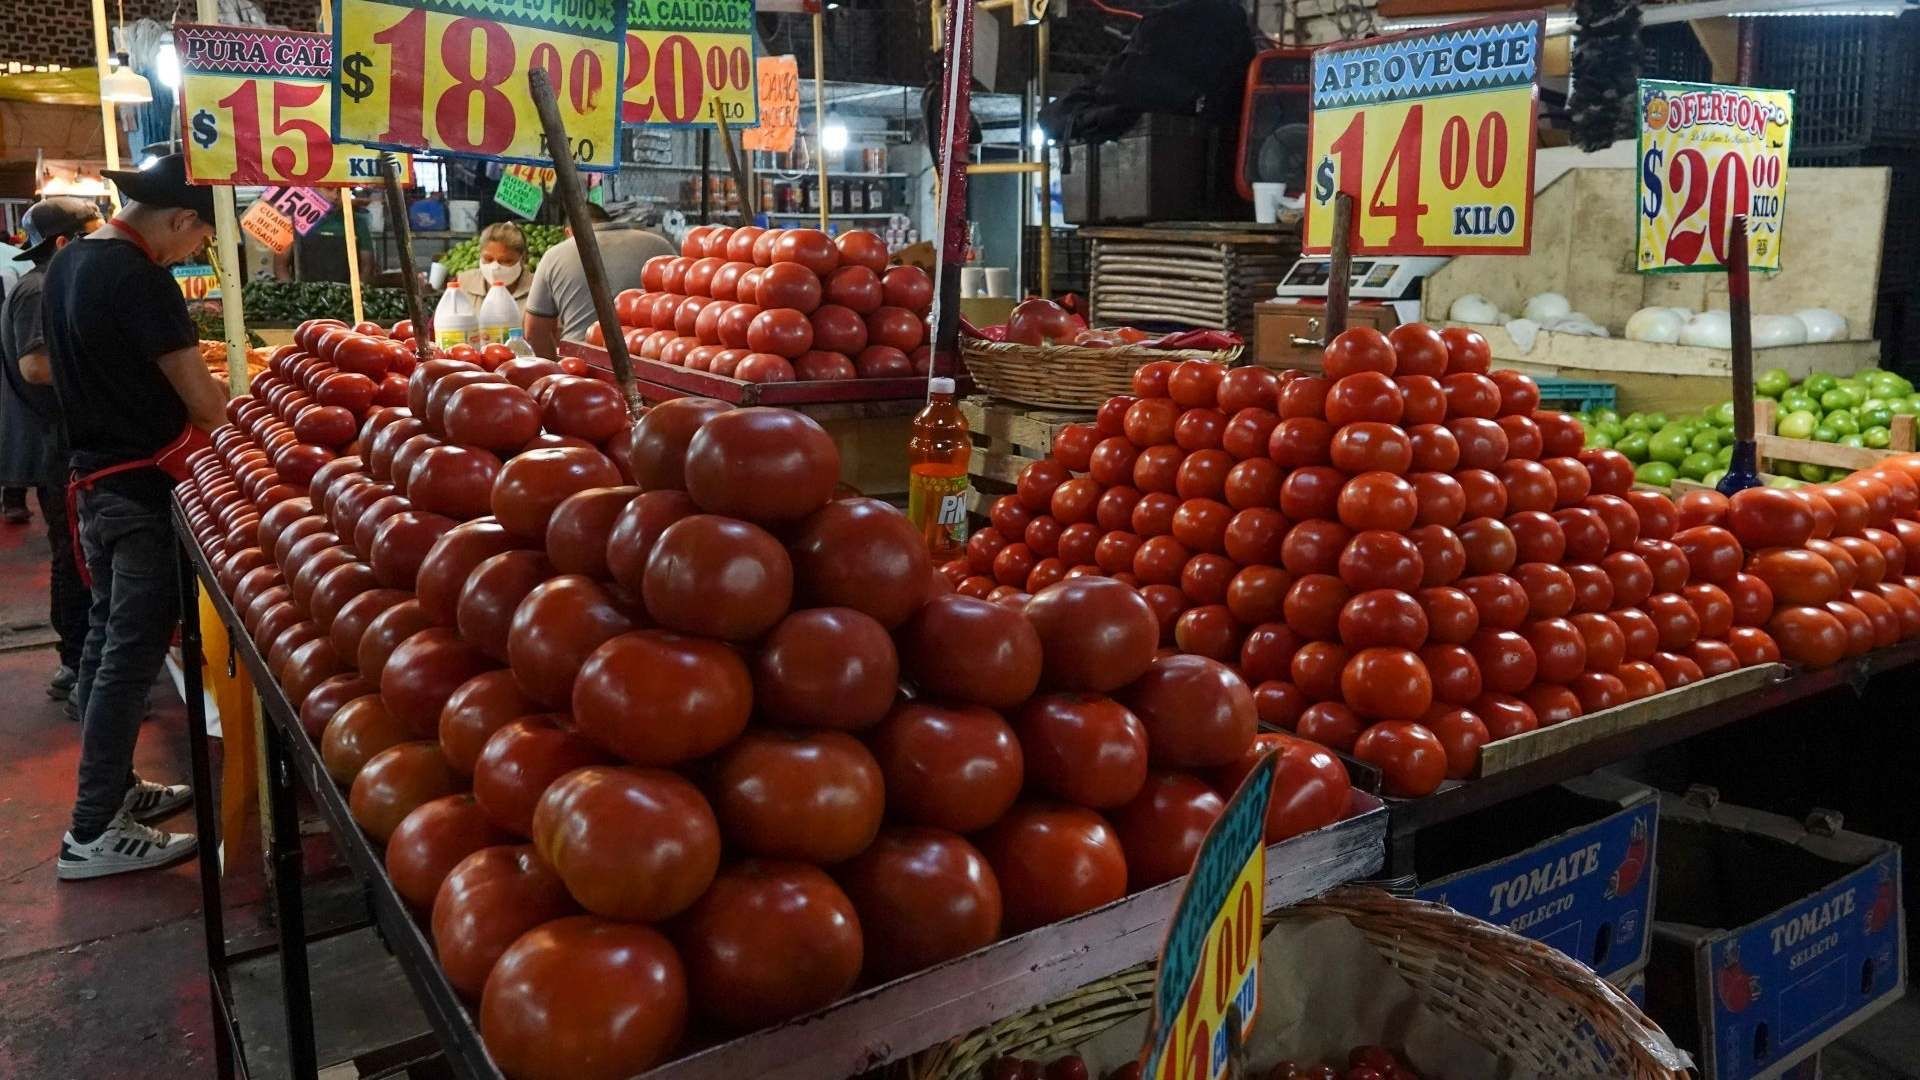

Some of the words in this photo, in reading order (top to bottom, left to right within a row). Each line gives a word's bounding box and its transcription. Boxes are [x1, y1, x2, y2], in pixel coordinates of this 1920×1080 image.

[550, 0, 596, 20] PIDIO
[656, 1, 740, 23] CALIDAD
[187, 38, 267, 64] PURA
[1319, 34, 1530, 93] APROVECHE
[1667, 91, 1769, 139] OFERTON
[1453, 205, 1515, 235] KILO
[1752, 195, 1779, 218] KILO
[1488, 842, 1602, 917] TOMATE
[1511, 893, 1575, 932] SELECTO
[1770, 887, 1856, 956] TOMATE
[1789, 931, 1839, 970] SELECTO
